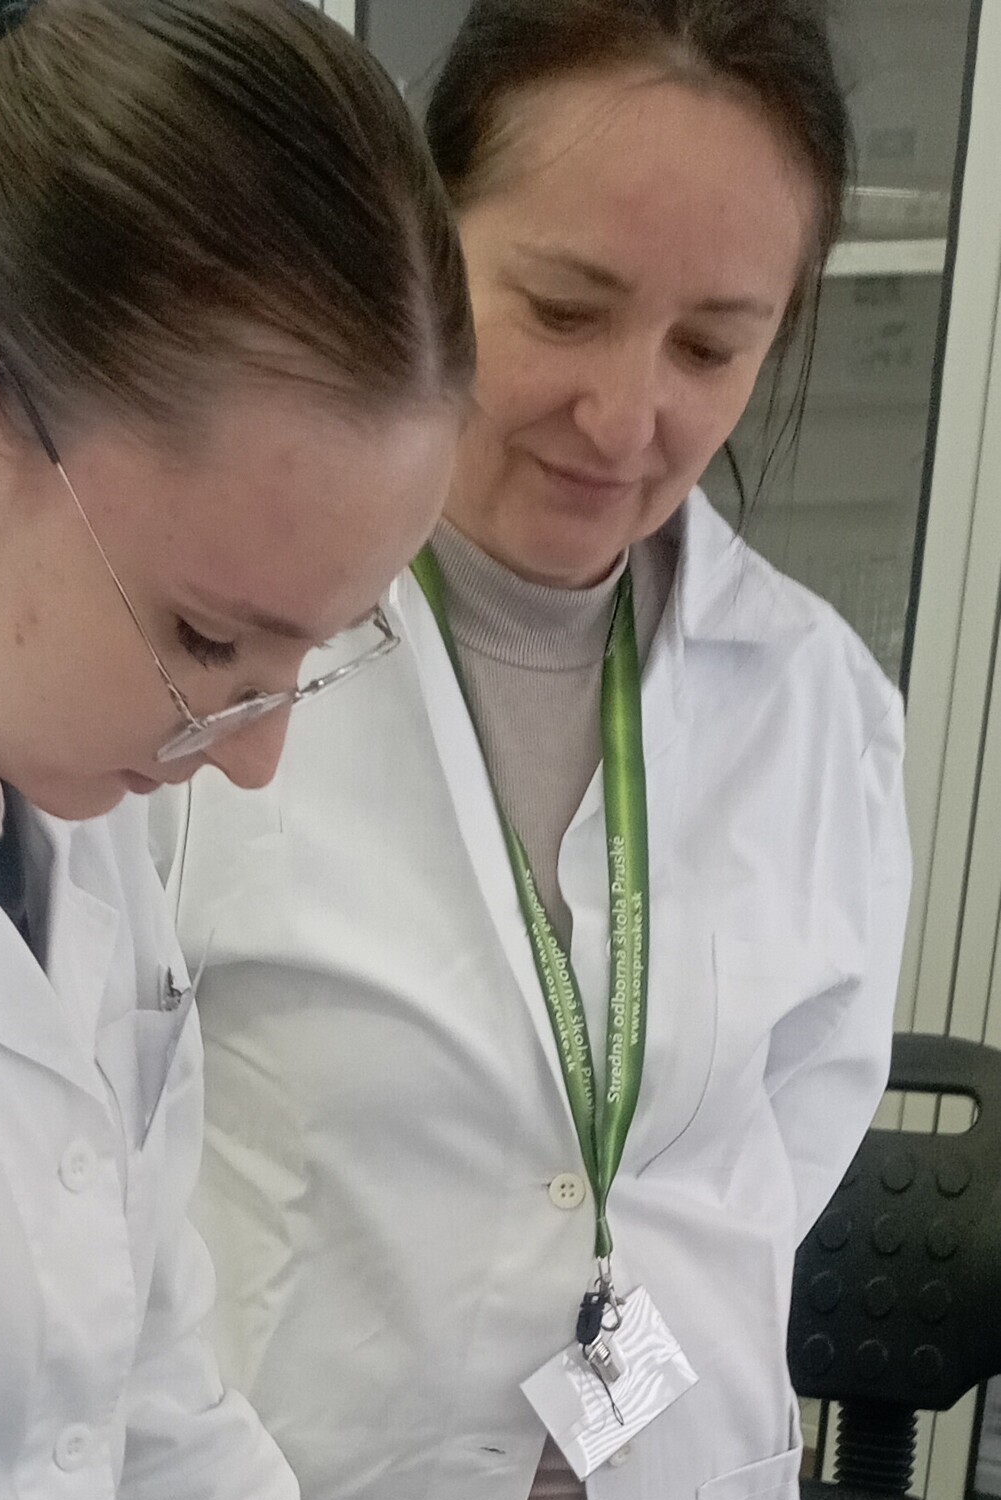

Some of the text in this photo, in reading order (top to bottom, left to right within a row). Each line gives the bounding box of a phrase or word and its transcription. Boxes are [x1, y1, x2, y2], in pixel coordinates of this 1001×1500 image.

[532, 922, 576, 1073] www.sospruske.sk
[548, 936, 580, 1010] odborná
[571, 1014, 588, 1062] škola
[607, 835, 628, 1103] Stredná odborná škola Pruské
[630, 891, 644, 1046] www.sospruske.sk
